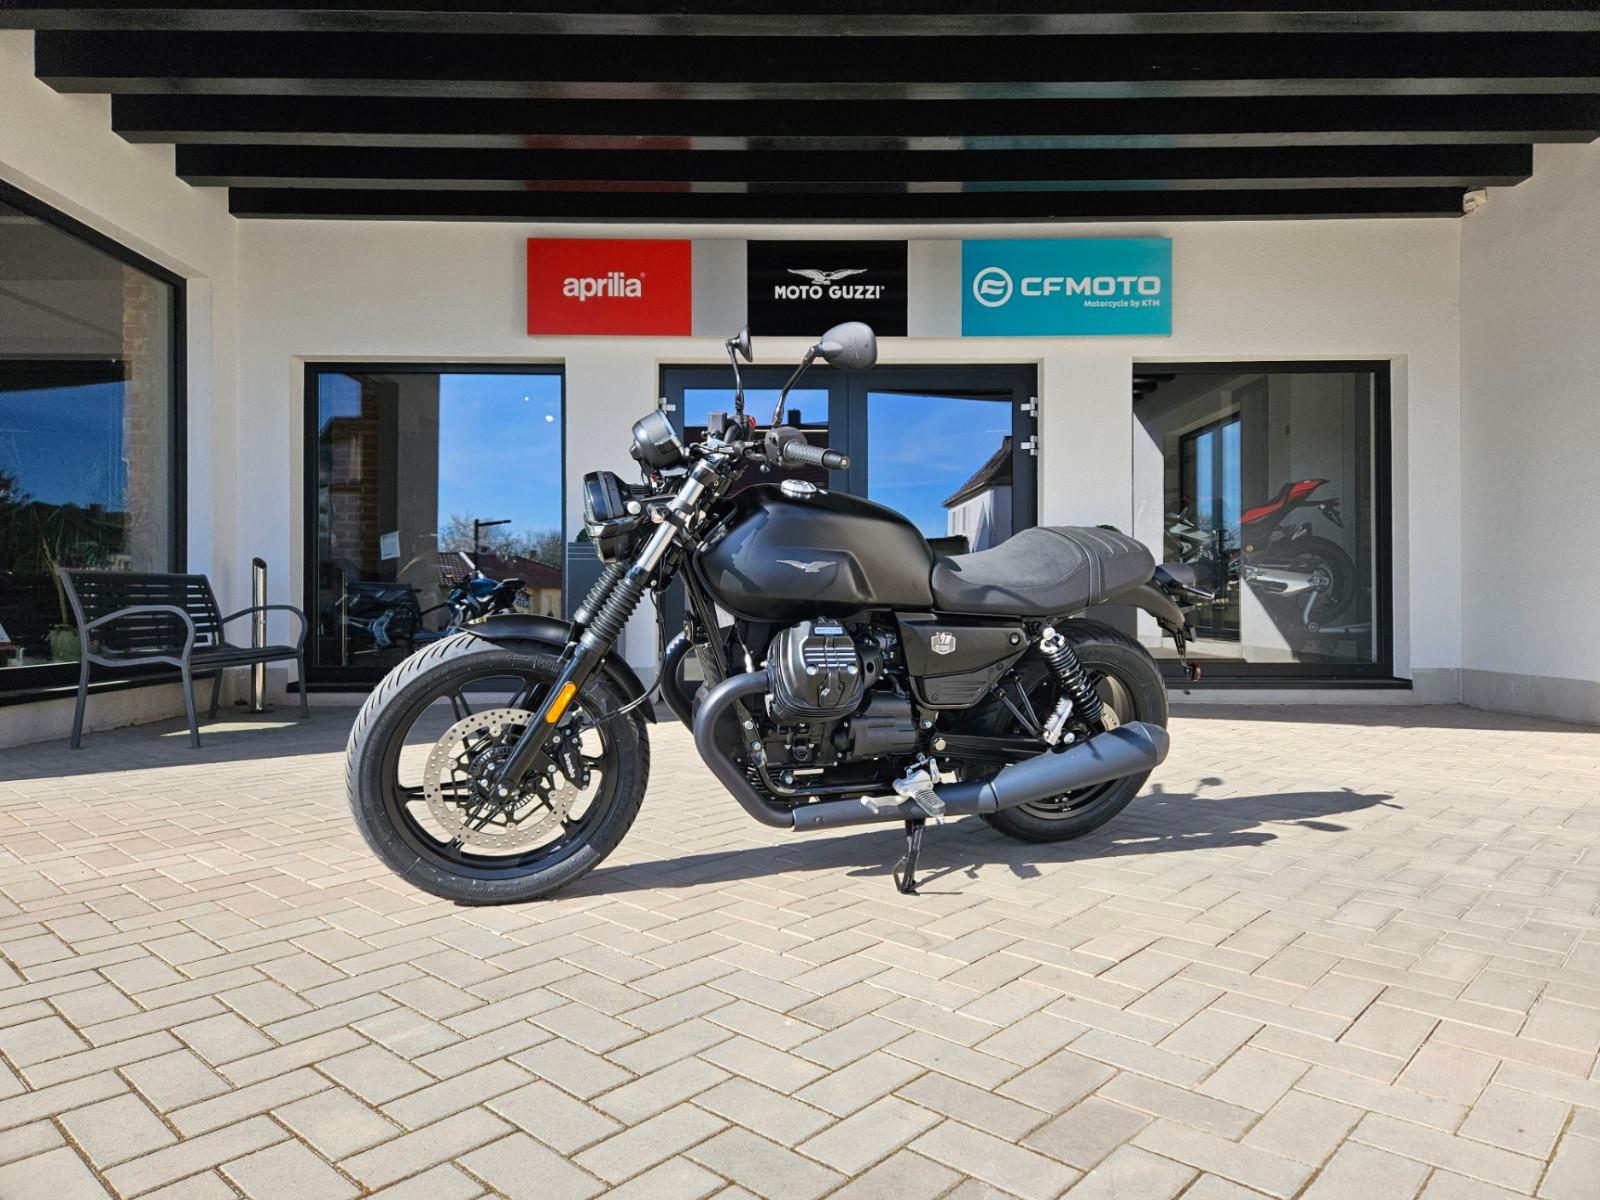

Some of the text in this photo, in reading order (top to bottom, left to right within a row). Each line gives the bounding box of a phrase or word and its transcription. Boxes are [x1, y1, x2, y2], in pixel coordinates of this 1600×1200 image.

[562, 271, 642, 302] aprilia
[774, 285, 880, 300] MOTO GUZZI
[1020, 276, 1161, 297] CFMOTO
[1083, 299, 1160, 308] Motorcycle by KTM
